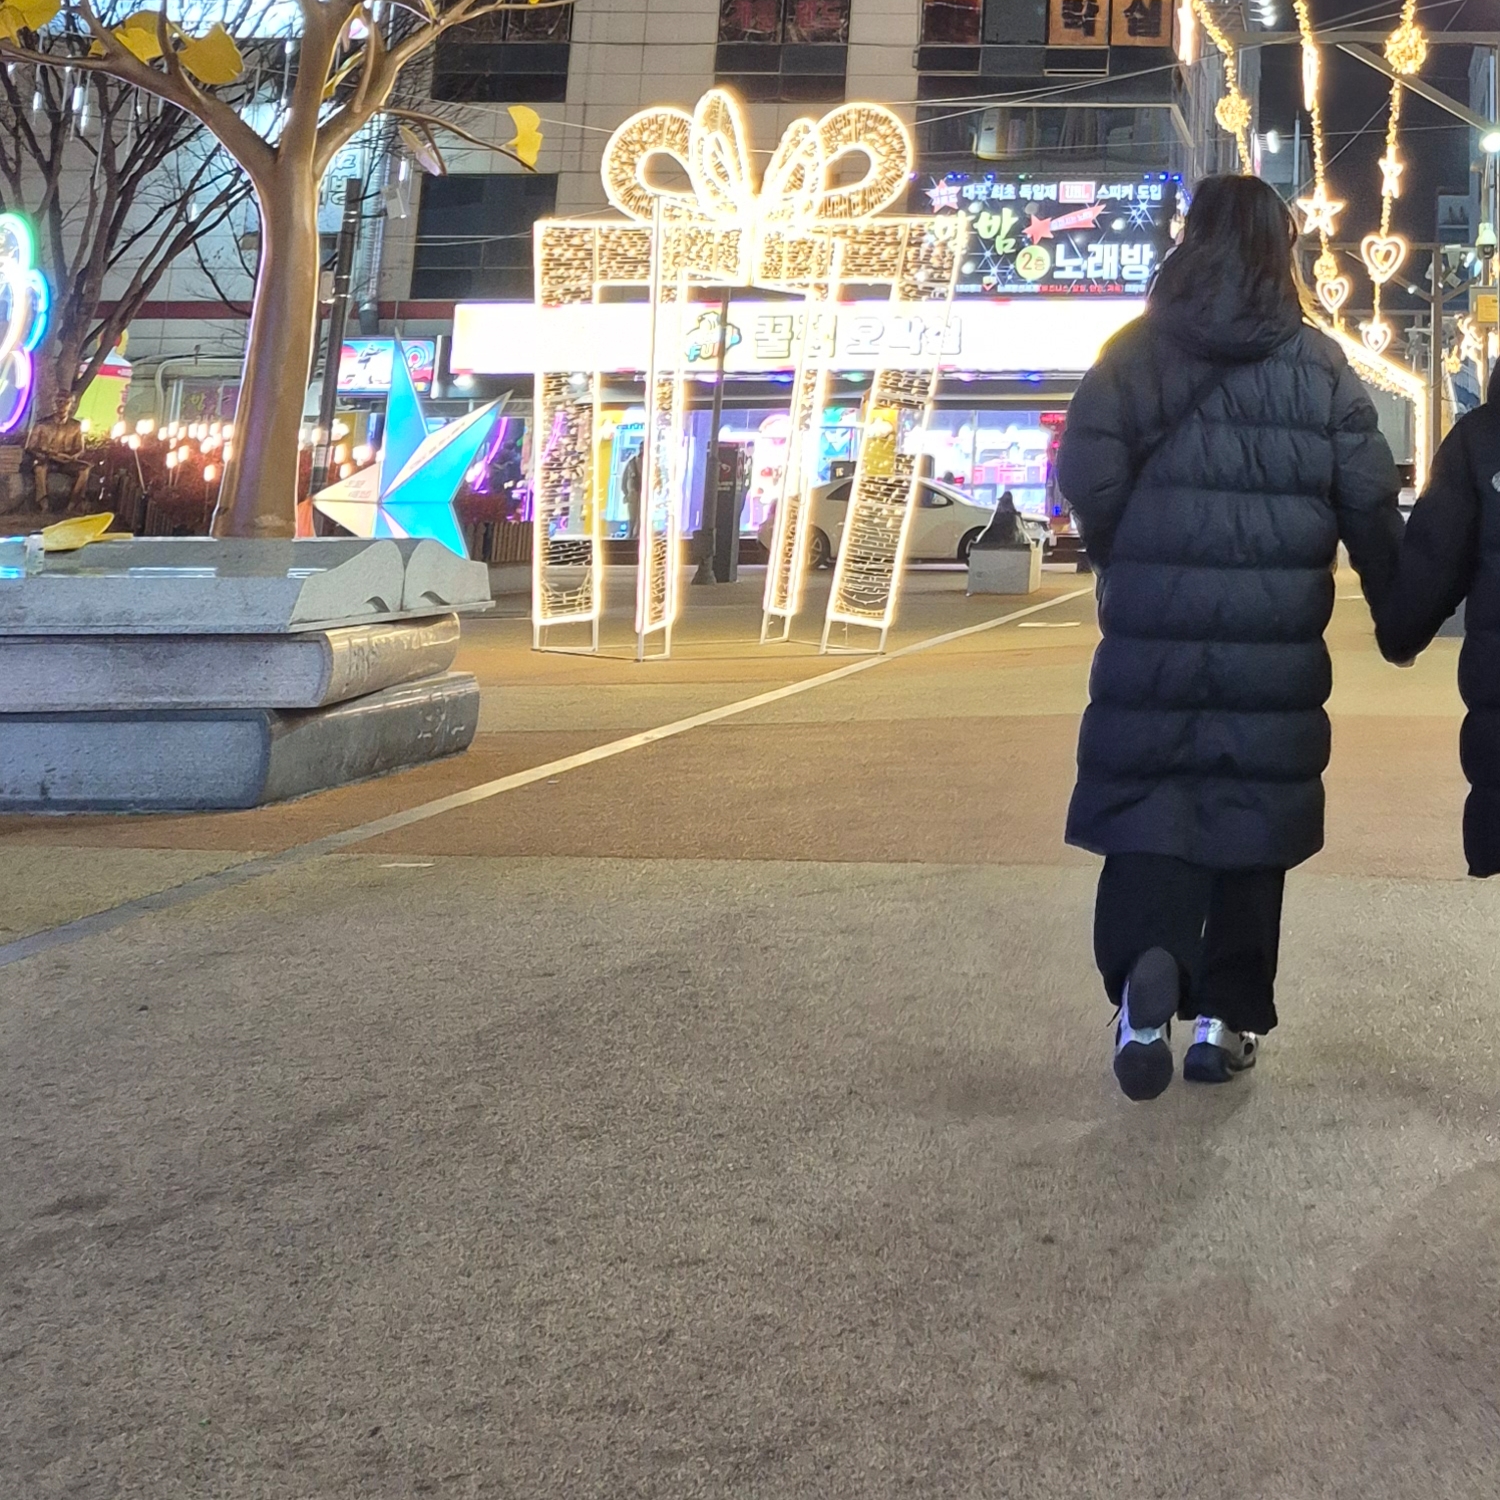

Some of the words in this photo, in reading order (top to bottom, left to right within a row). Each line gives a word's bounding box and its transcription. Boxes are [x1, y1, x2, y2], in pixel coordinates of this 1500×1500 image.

[1096, 184, 1133, 200] 스피커
[1136, 184, 1162, 200] 도입
[1053, 244, 1153, 280] 노래방
[846, 316, 962, 356] 오락실
